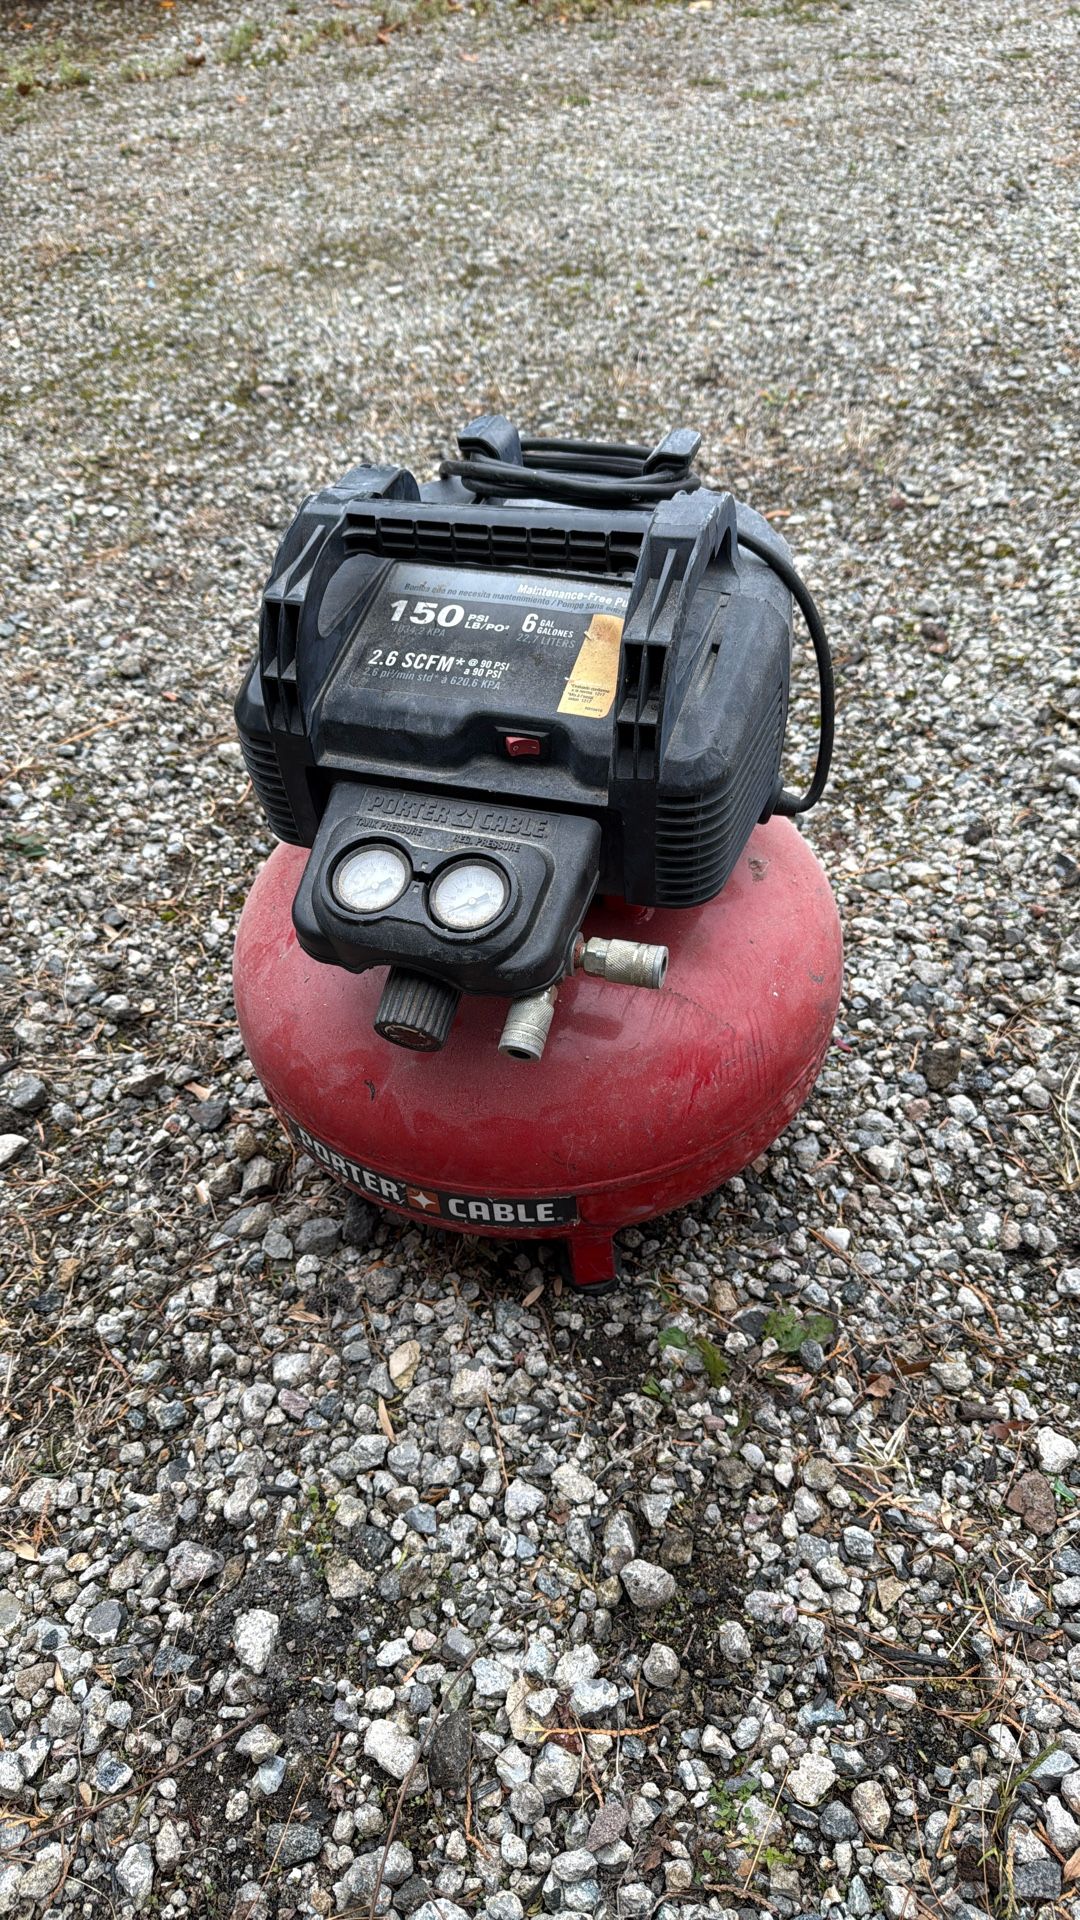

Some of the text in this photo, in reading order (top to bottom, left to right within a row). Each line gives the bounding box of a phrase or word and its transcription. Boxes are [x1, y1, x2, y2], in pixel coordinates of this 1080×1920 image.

[458, 589, 491, 599] necesita
[492, 592, 550, 606] mantenimiento
[557, 599, 584, 610] Pompe
[517, 584, 629, 608] Maintenance-Free Pu
[390, 600, 465, 628] 150
[467, 614, 490, 623] PSI
[521, 613, 539, 633] 6
[426, 627, 446, 637] KPA
[536, 626, 574, 638] GALONES
[539, 619, 555, 628] GAL
[540, 636, 576, 649] LITERS
[367, 649, 399, 666] 2.6
[467, 658, 479, 667] @
[480, 659, 493, 669] 90
[493, 661, 510, 671] PSI
[472, 668, 485, 677] 90
[485, 669, 502, 679] PSI
[480, 679, 501, 690] KPA
[368, 796, 548, 839] PORTER CABLE
[356, 817, 424, 837] TANK PRESSURE
[475, 837, 522, 853] PRESSURE
[298, 1127, 555, 1223] PORTER CABLE
